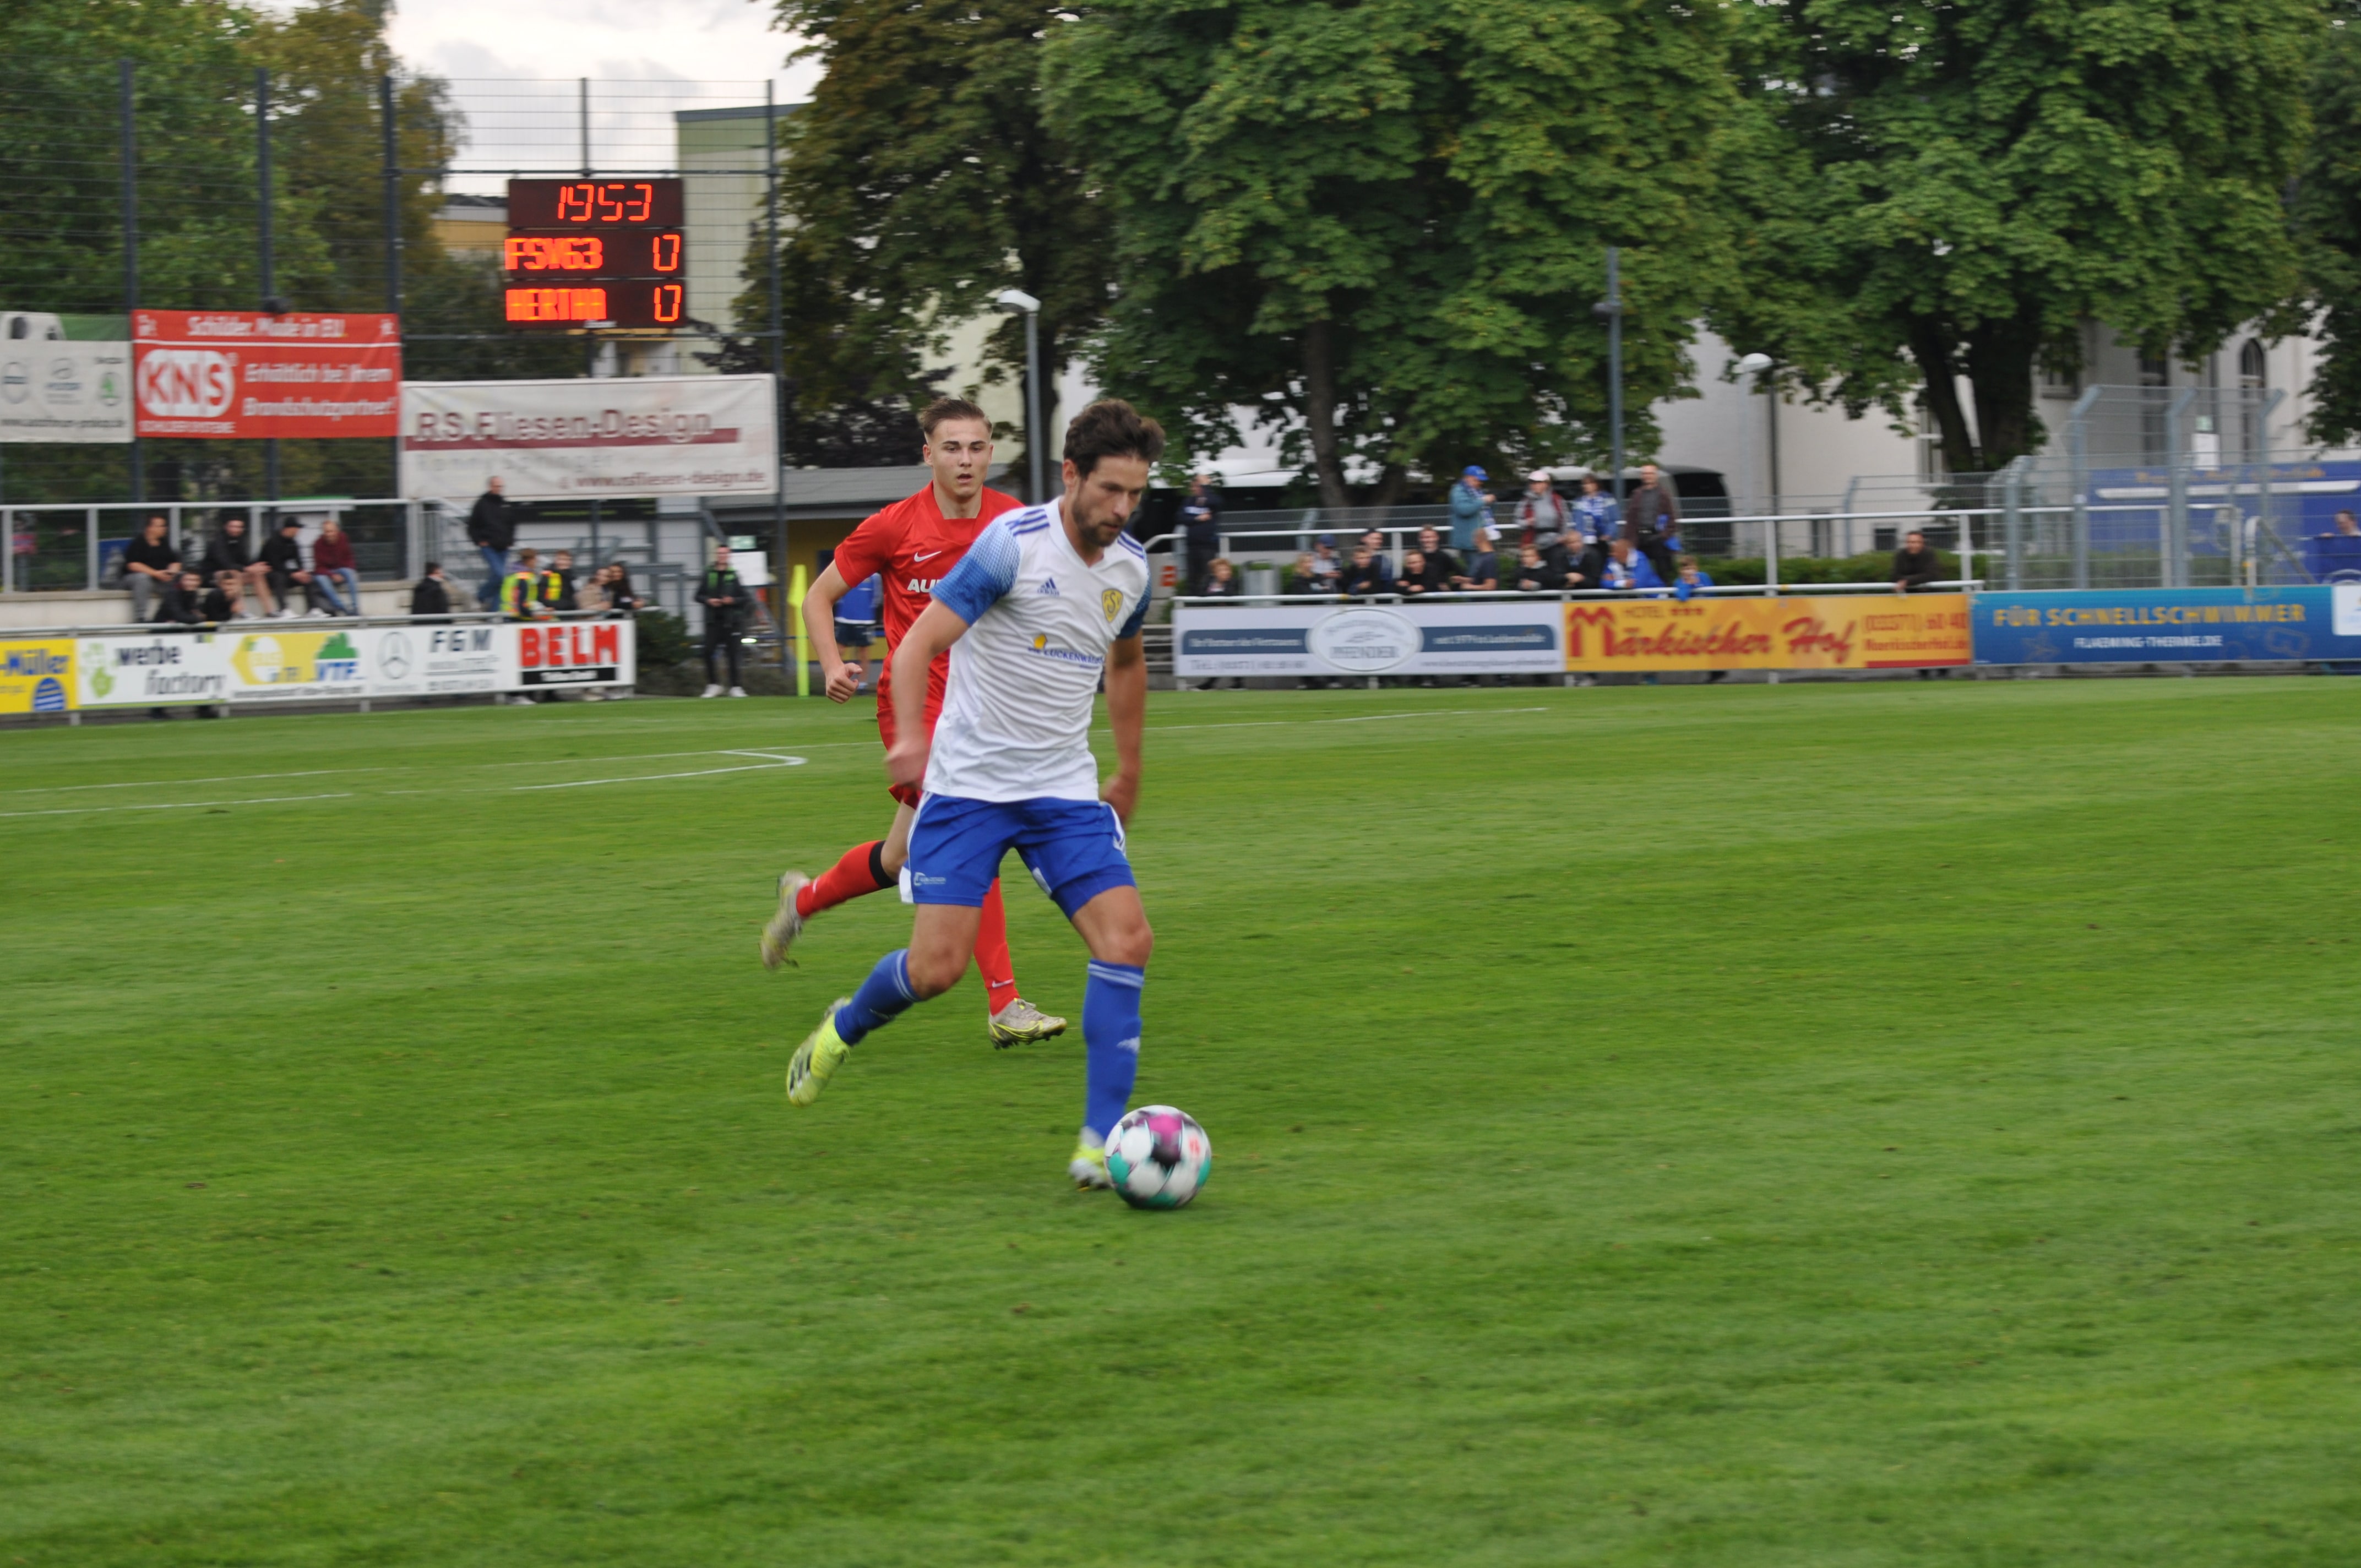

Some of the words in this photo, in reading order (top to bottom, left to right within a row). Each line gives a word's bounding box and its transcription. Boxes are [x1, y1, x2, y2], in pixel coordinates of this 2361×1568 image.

[653, 235, 681, 270] 0
[654, 285, 681, 321] 0
[142, 361, 226, 407] KNS
[417, 412, 464, 440] RS
[474, 408, 712, 443] Fliesen-Design
[907, 578, 941, 594] AU
[1993, 605, 2042, 627] FÜR
[2046, 603, 2306, 626] SCHNELLSCHWIMMER
[115, 639, 182, 666] werbe
[519, 624, 620, 667] BELM
[1569, 606, 1772, 657] Märkischer
[1782, 616, 1857, 665] Hof
[144, 668, 226, 699] factory
